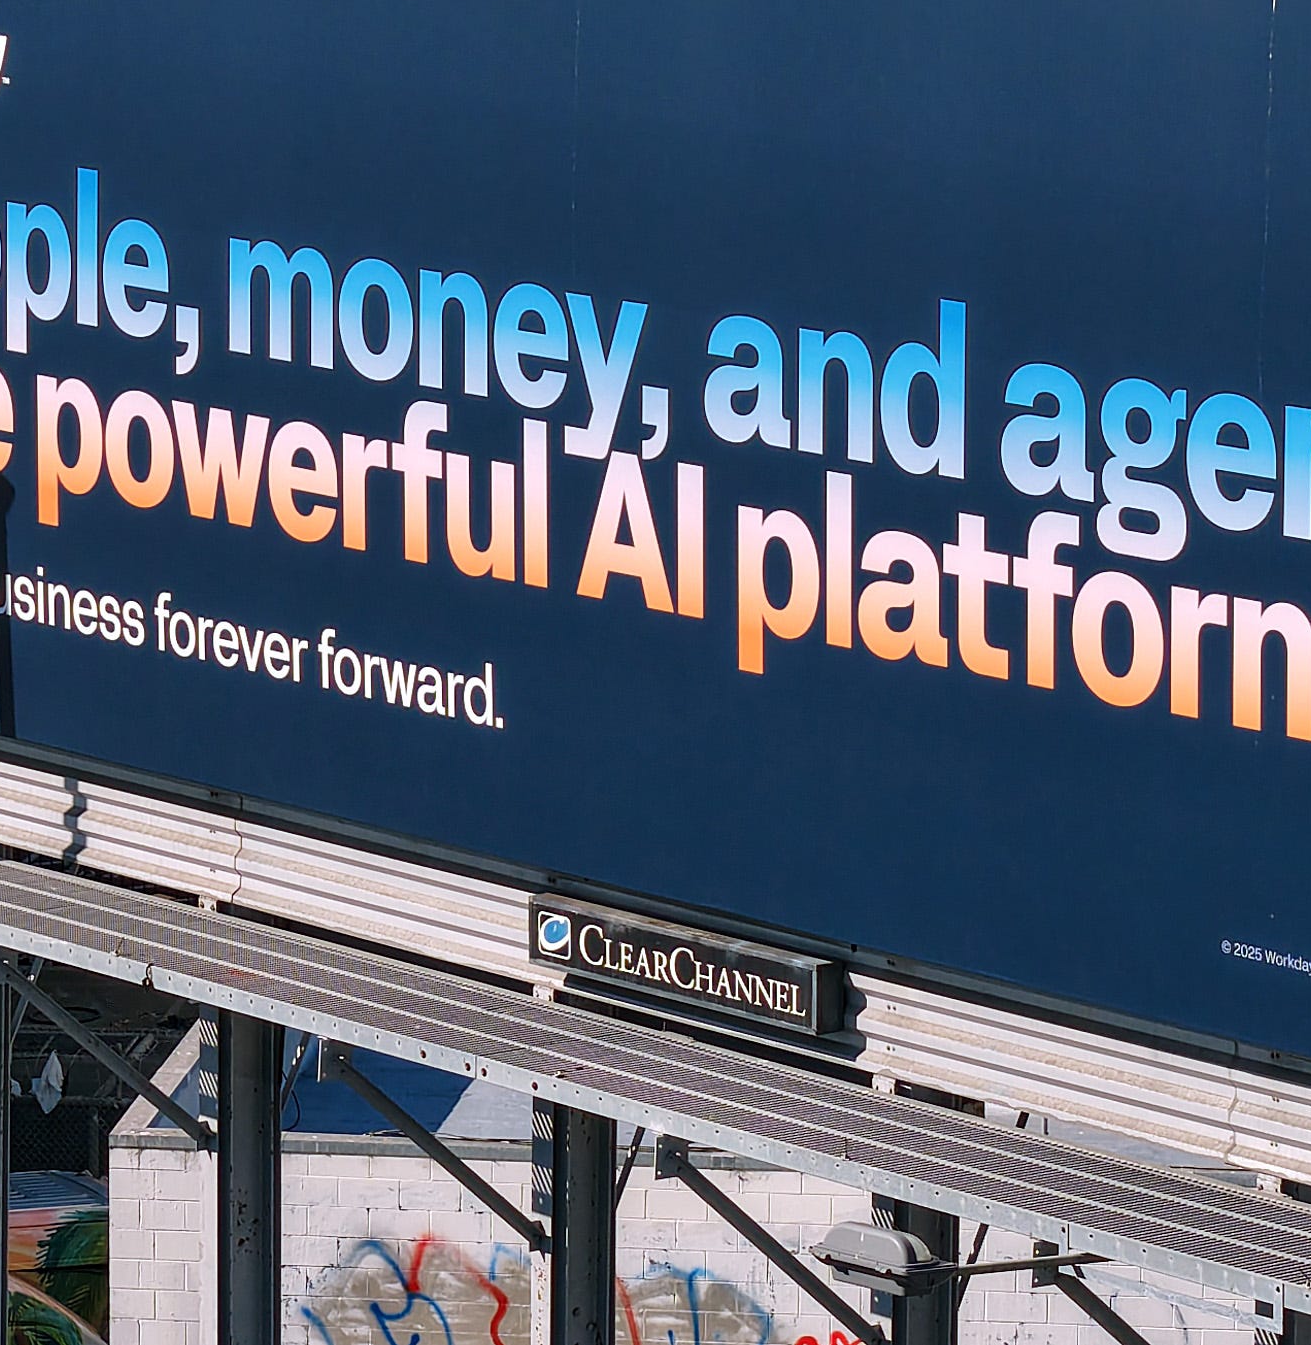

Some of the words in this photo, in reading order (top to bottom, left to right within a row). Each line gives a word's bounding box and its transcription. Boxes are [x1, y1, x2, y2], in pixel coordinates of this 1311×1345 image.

[229, 235, 670, 460] money,
[703, 298, 968, 480] and
[36, 373, 550, 589] powerful
[576, 450, 705, 619] AI
[154, 592, 310, 683] forever
[317, 628, 505, 730] forward.
[1233, 942, 1263, 962] 2025
